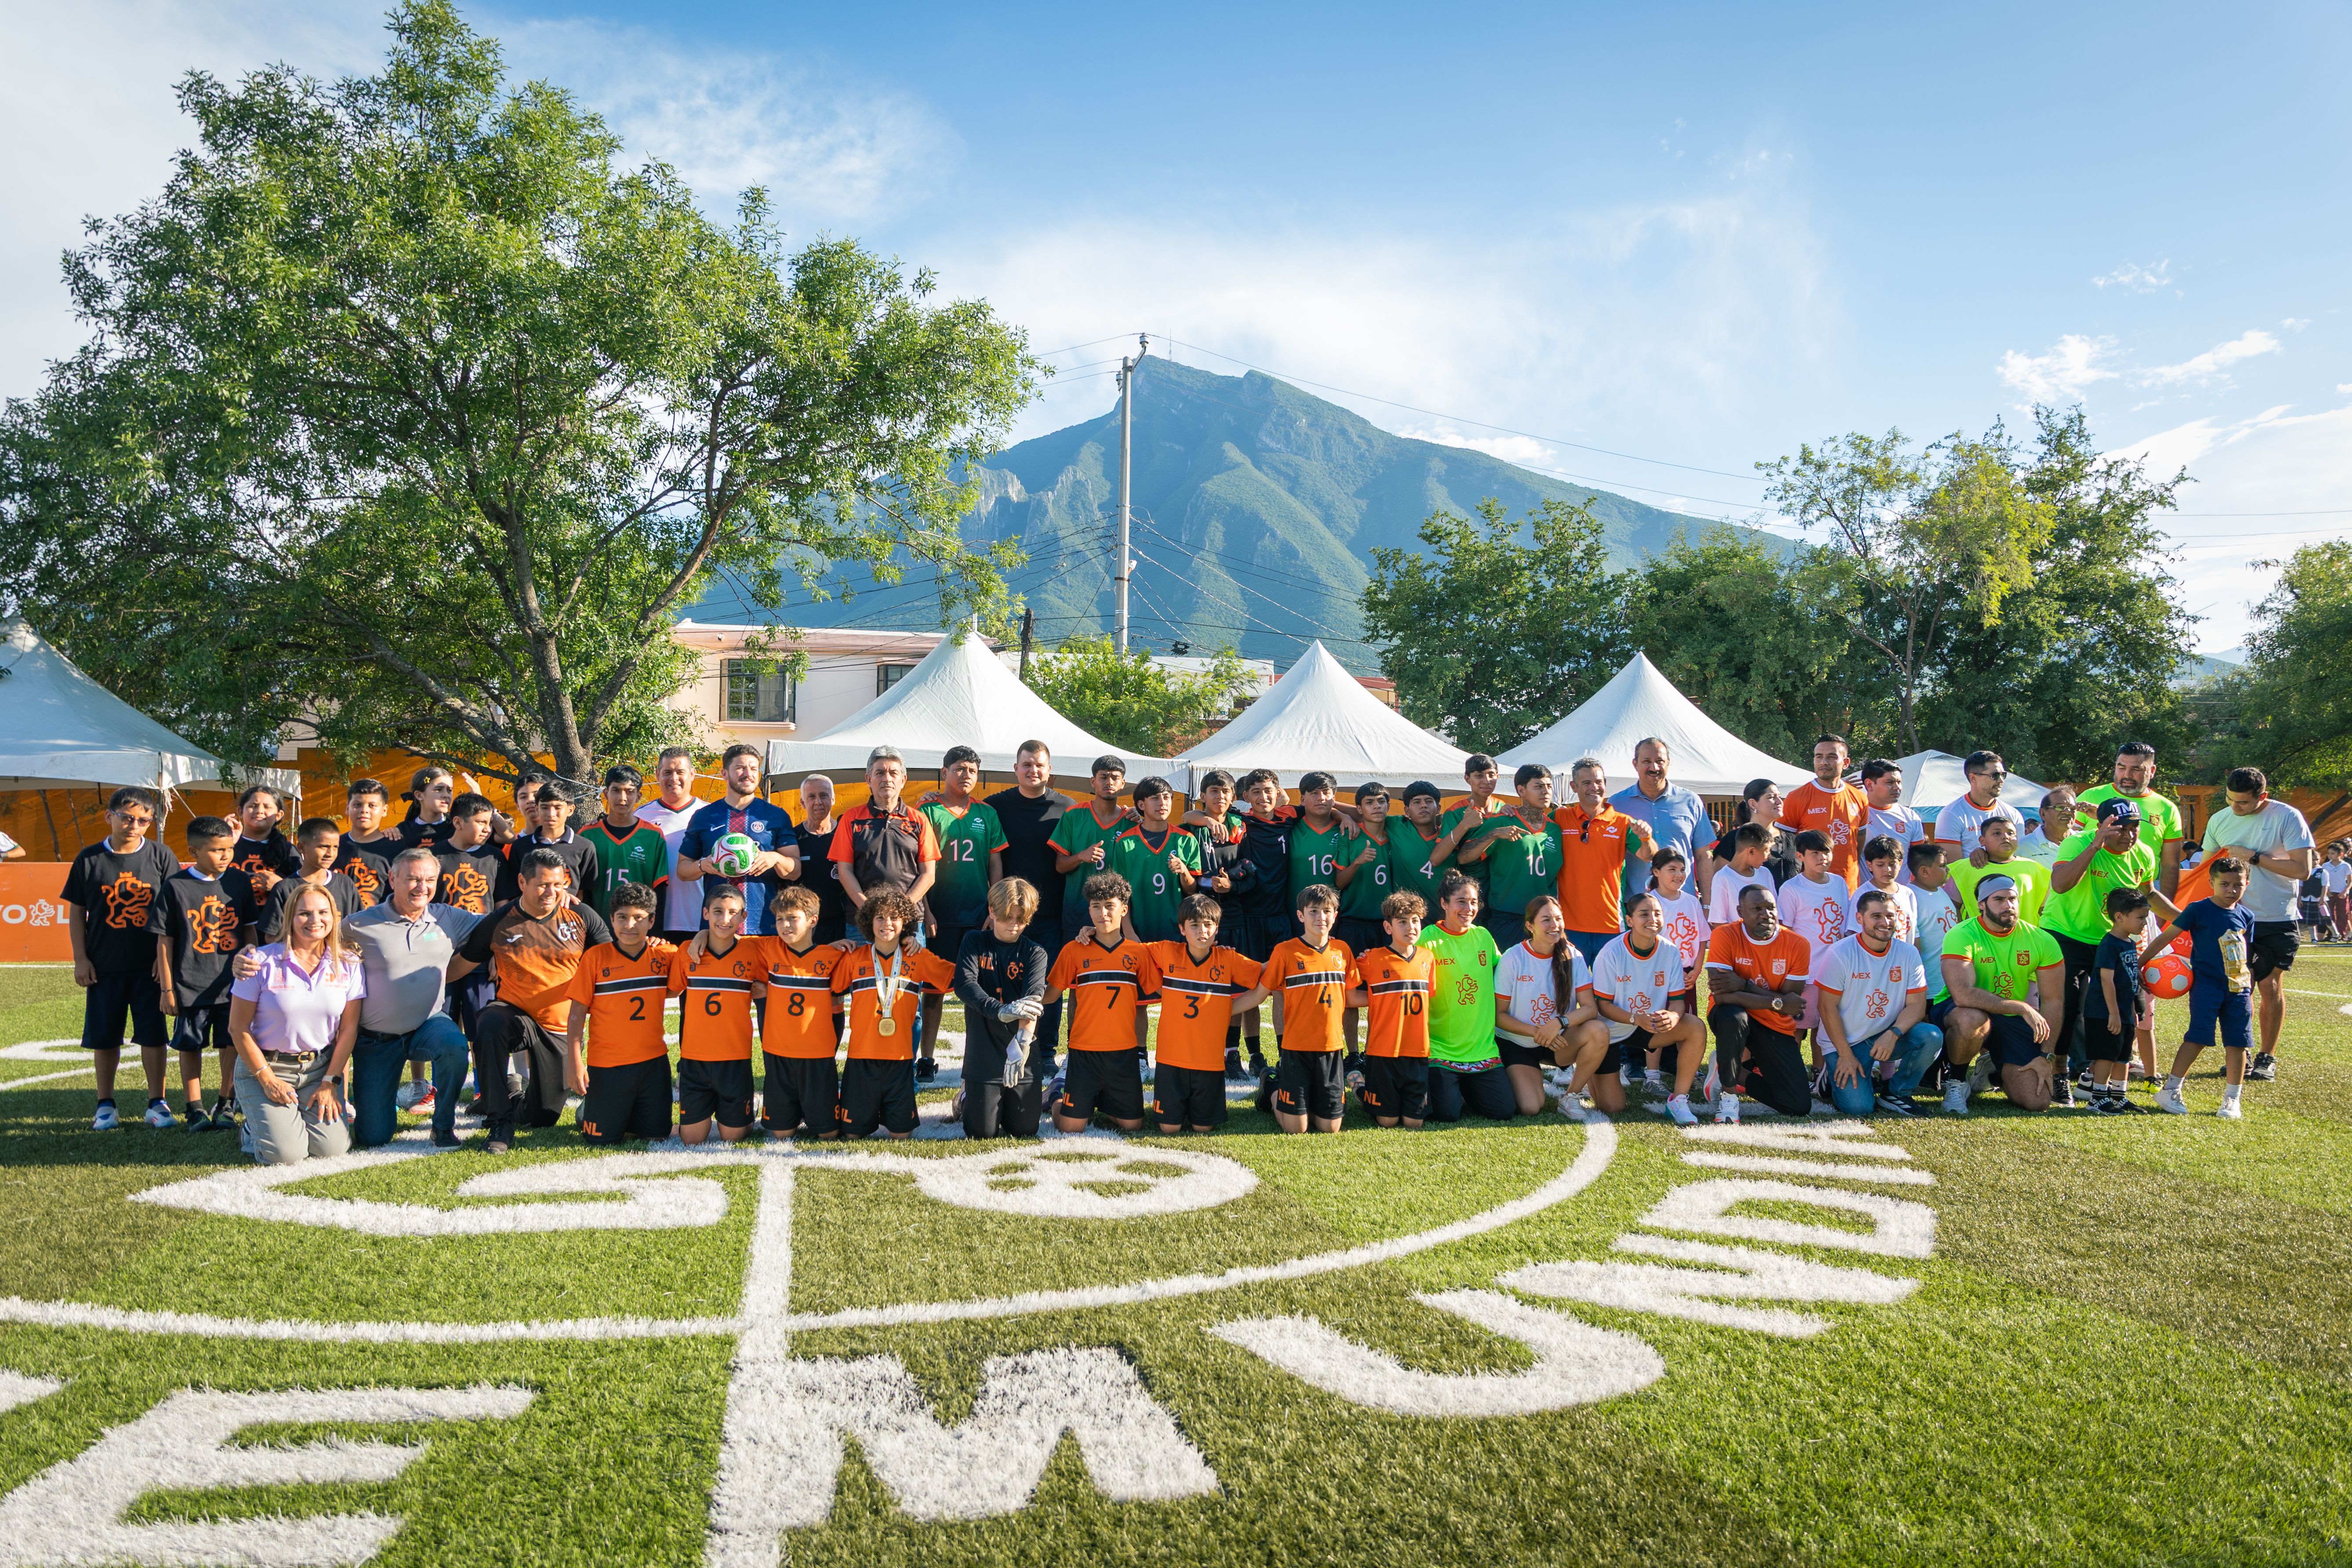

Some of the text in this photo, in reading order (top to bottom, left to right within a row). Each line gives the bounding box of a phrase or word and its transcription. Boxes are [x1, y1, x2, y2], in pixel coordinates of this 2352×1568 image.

[950, 839, 974, 861] 12
[1308, 854, 1332, 875] 16
[1375, 864, 1387, 885] 6
[1420, 860, 1434, 879] 4
[1526, 854, 1546, 876] 10
[2091, 869, 2109, 878] MEX
[606, 868, 629, 891] 15
[1153, 873, 1165, 895] 9
[0, 904, 27, 924] O
[1735, 956, 1753, 966] MEX
[705, 992, 722, 1016] 6
[788, 992, 805, 1016] 8
[1106, 986, 1121, 1009] 7
[1183, 995, 1199, 1019] 3
[1319, 986, 1333, 1008] 4
[1401, 993, 1423, 1016] 10
[629, 996, 645, 1020] 2
[1279, 1088, 1295, 1105] NL
[1364, 1090, 1381, 1106] NL
[746, 1100, 750, 1115] 6
[835, 1104, 840, 1120] 8
[583, 1120, 602, 1136] NL
